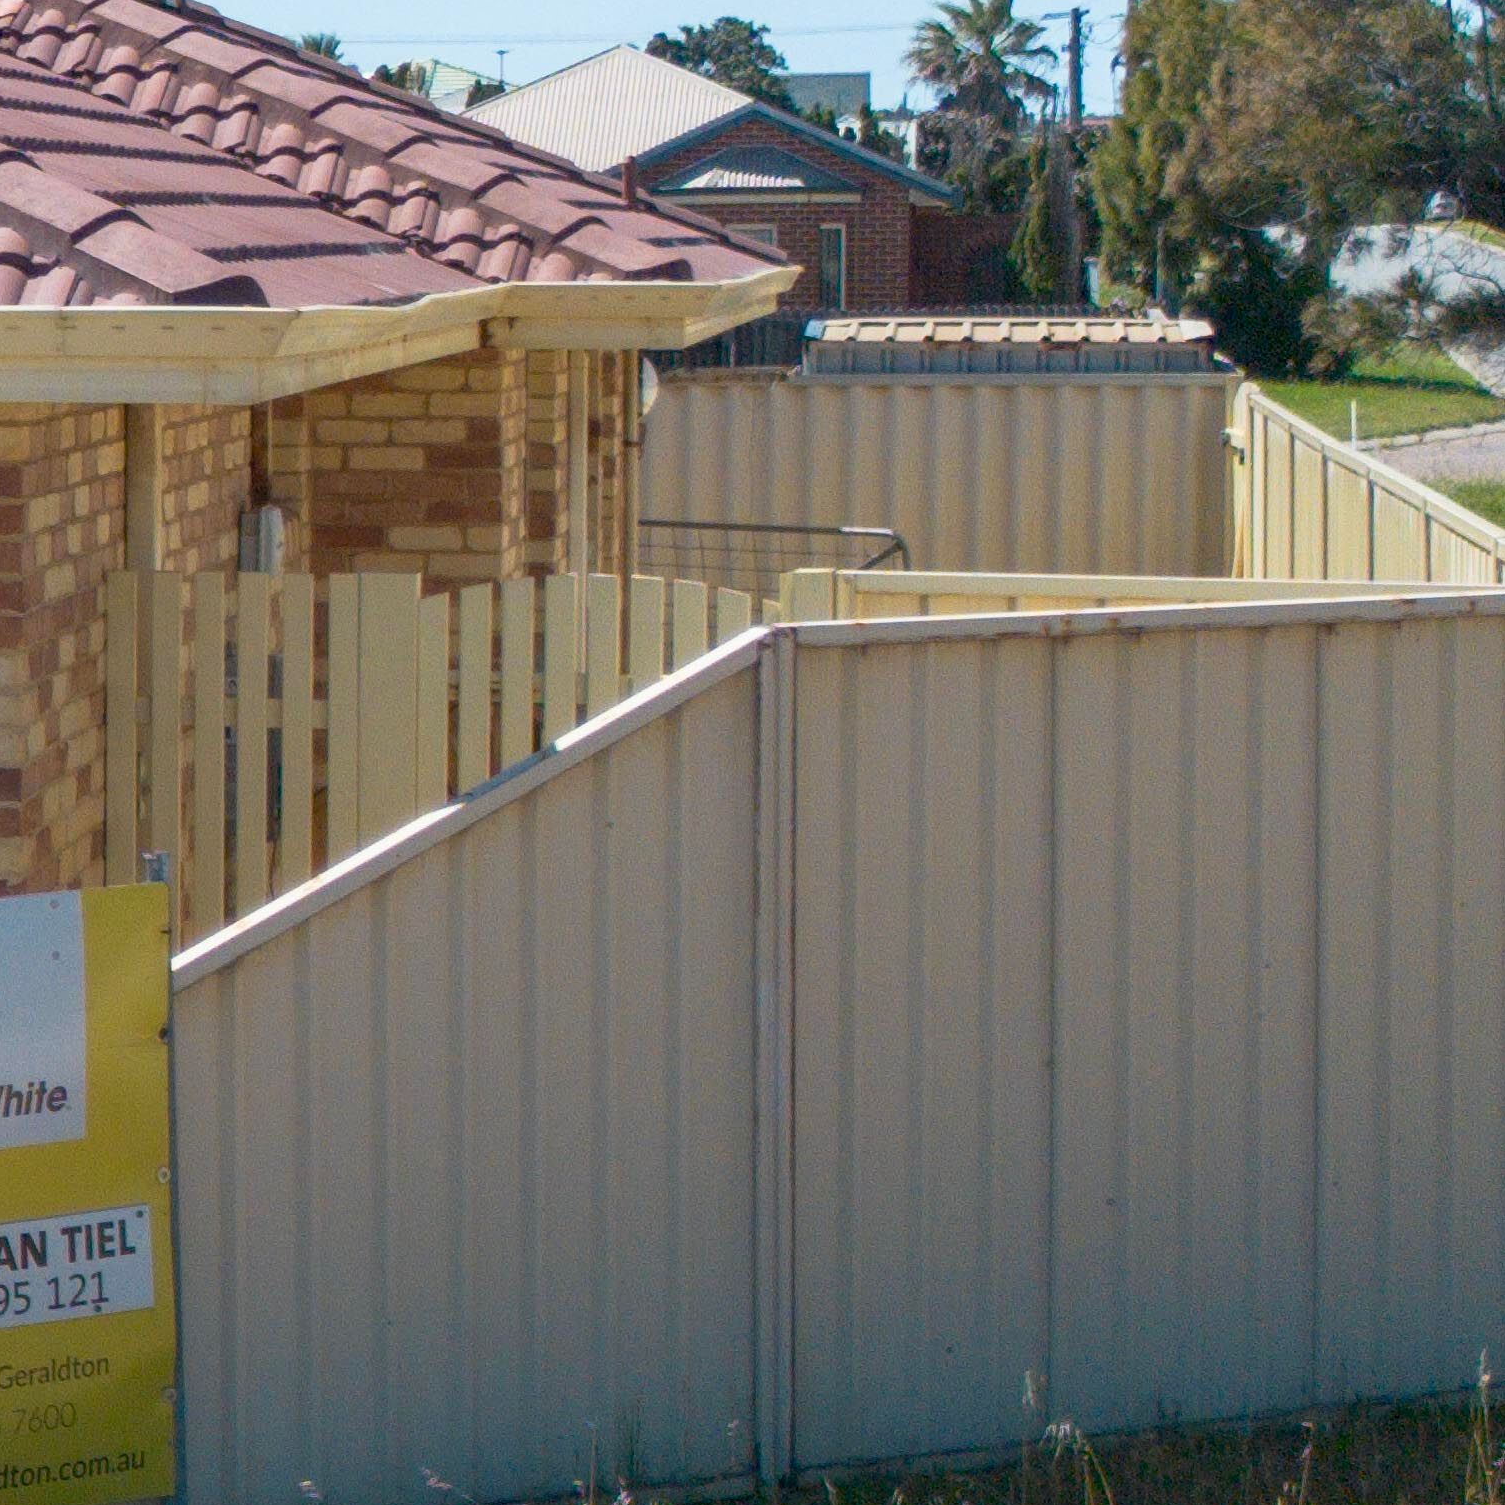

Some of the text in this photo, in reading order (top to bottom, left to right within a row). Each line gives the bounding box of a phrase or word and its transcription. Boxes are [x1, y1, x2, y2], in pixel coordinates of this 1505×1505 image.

[61, 1219, 136, 1263] TIEL
[47, 1271, 109, 1310] 121
[12, 1402, 77, 1434] 7600
